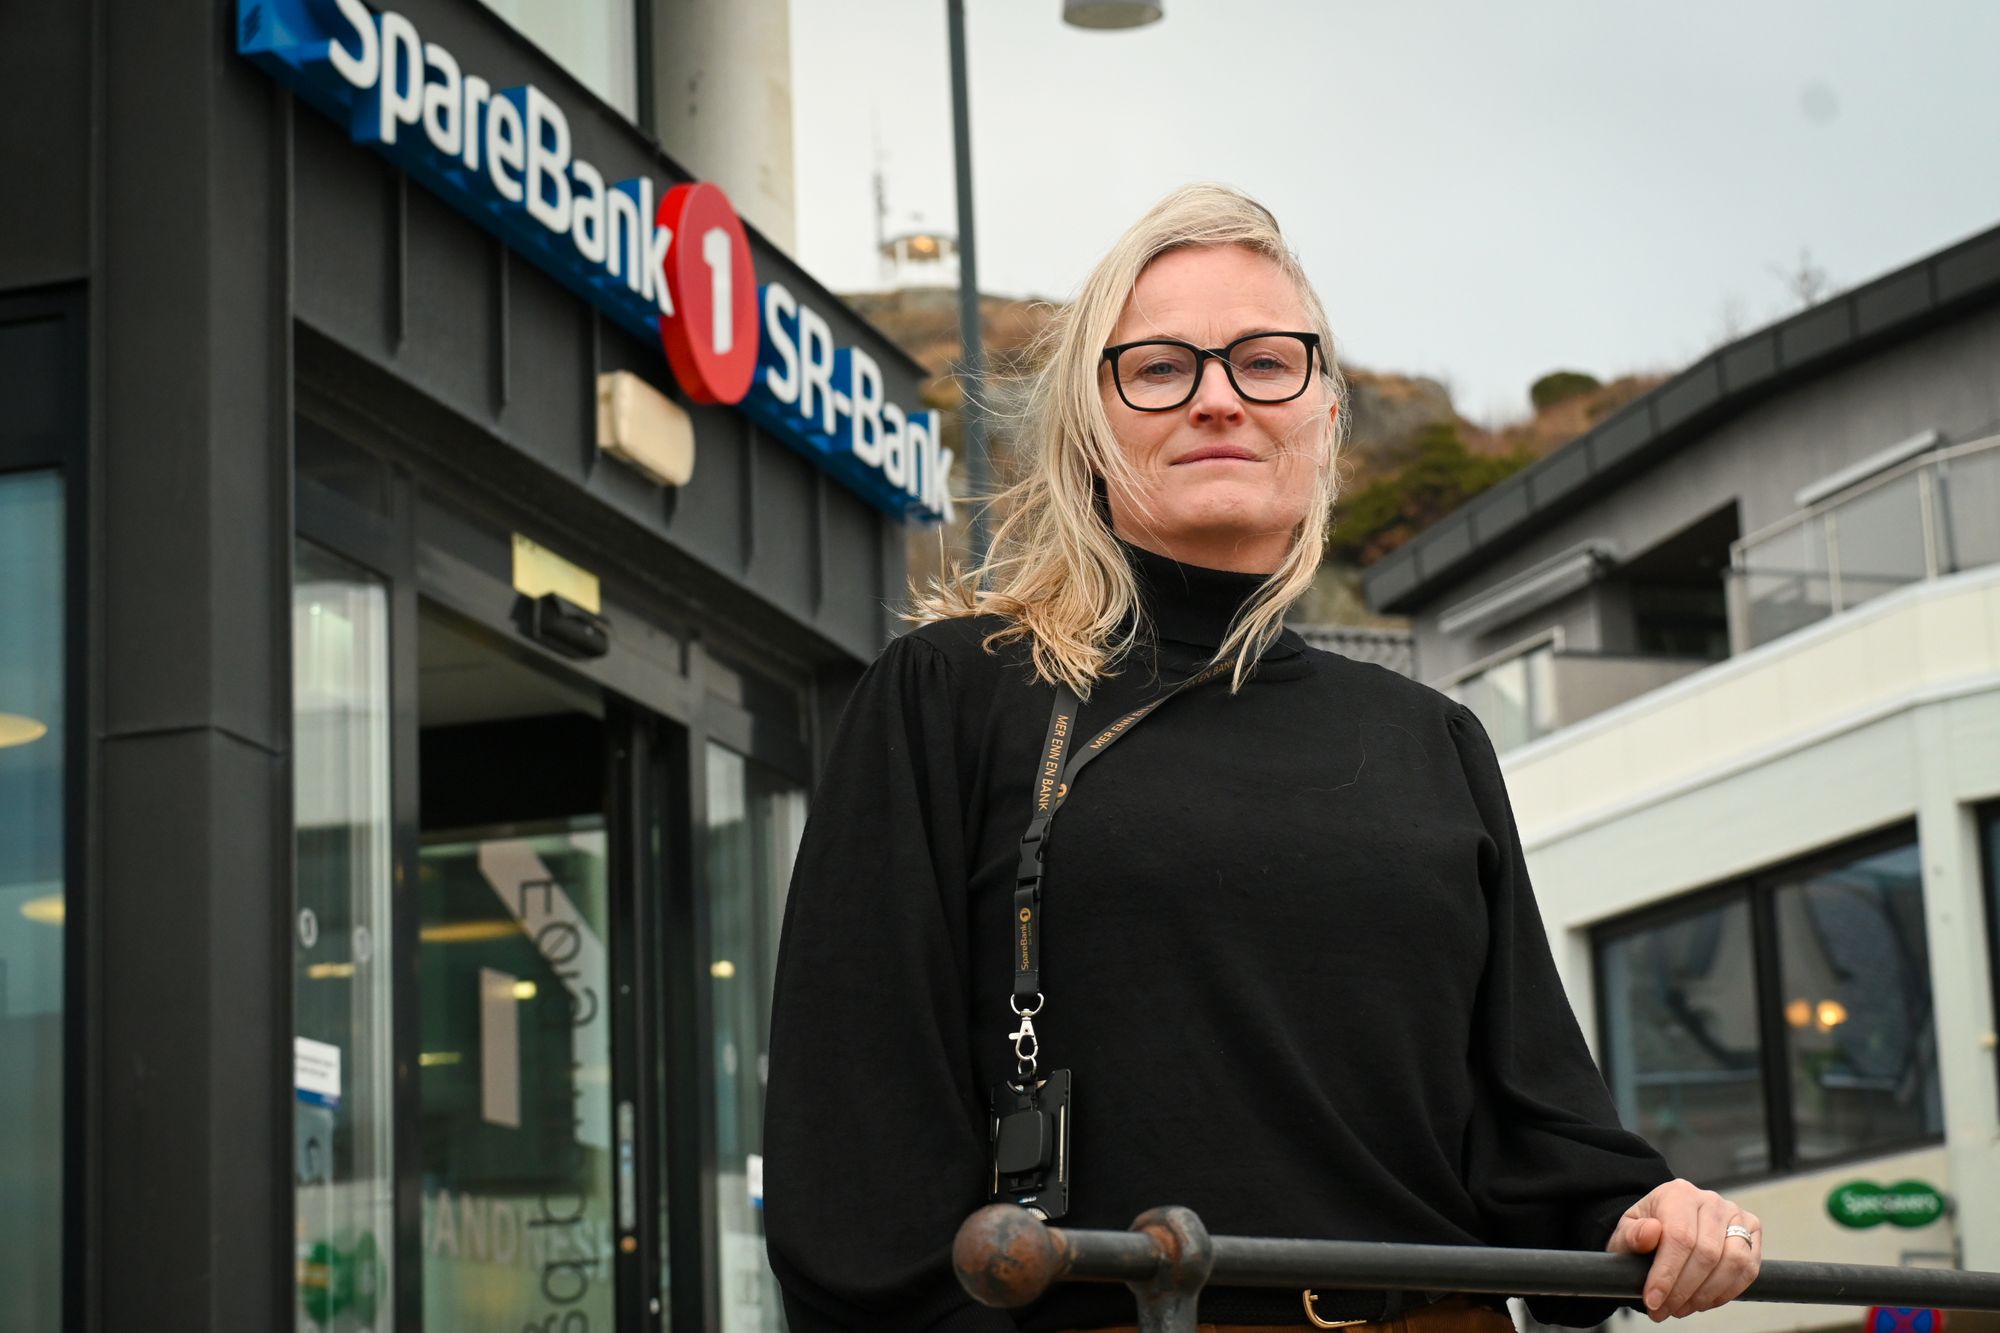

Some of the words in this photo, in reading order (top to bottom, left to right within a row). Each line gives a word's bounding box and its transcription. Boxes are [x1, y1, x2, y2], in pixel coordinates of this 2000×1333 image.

[329, 0, 675, 316] SpareBank
[702, 227, 734, 355] 1
[764, 282, 956, 523] SR-Bank
[1054, 714, 1069, 737] MER
[1090, 731, 1116, 749] MER
[1111, 716, 1136, 732] ENN
[1048, 738, 1064, 760] ENN
[1044, 761, 1058, 777] EN
[1038, 778, 1054, 812] BANK
[1020, 923, 1030, 971] SpareBank
